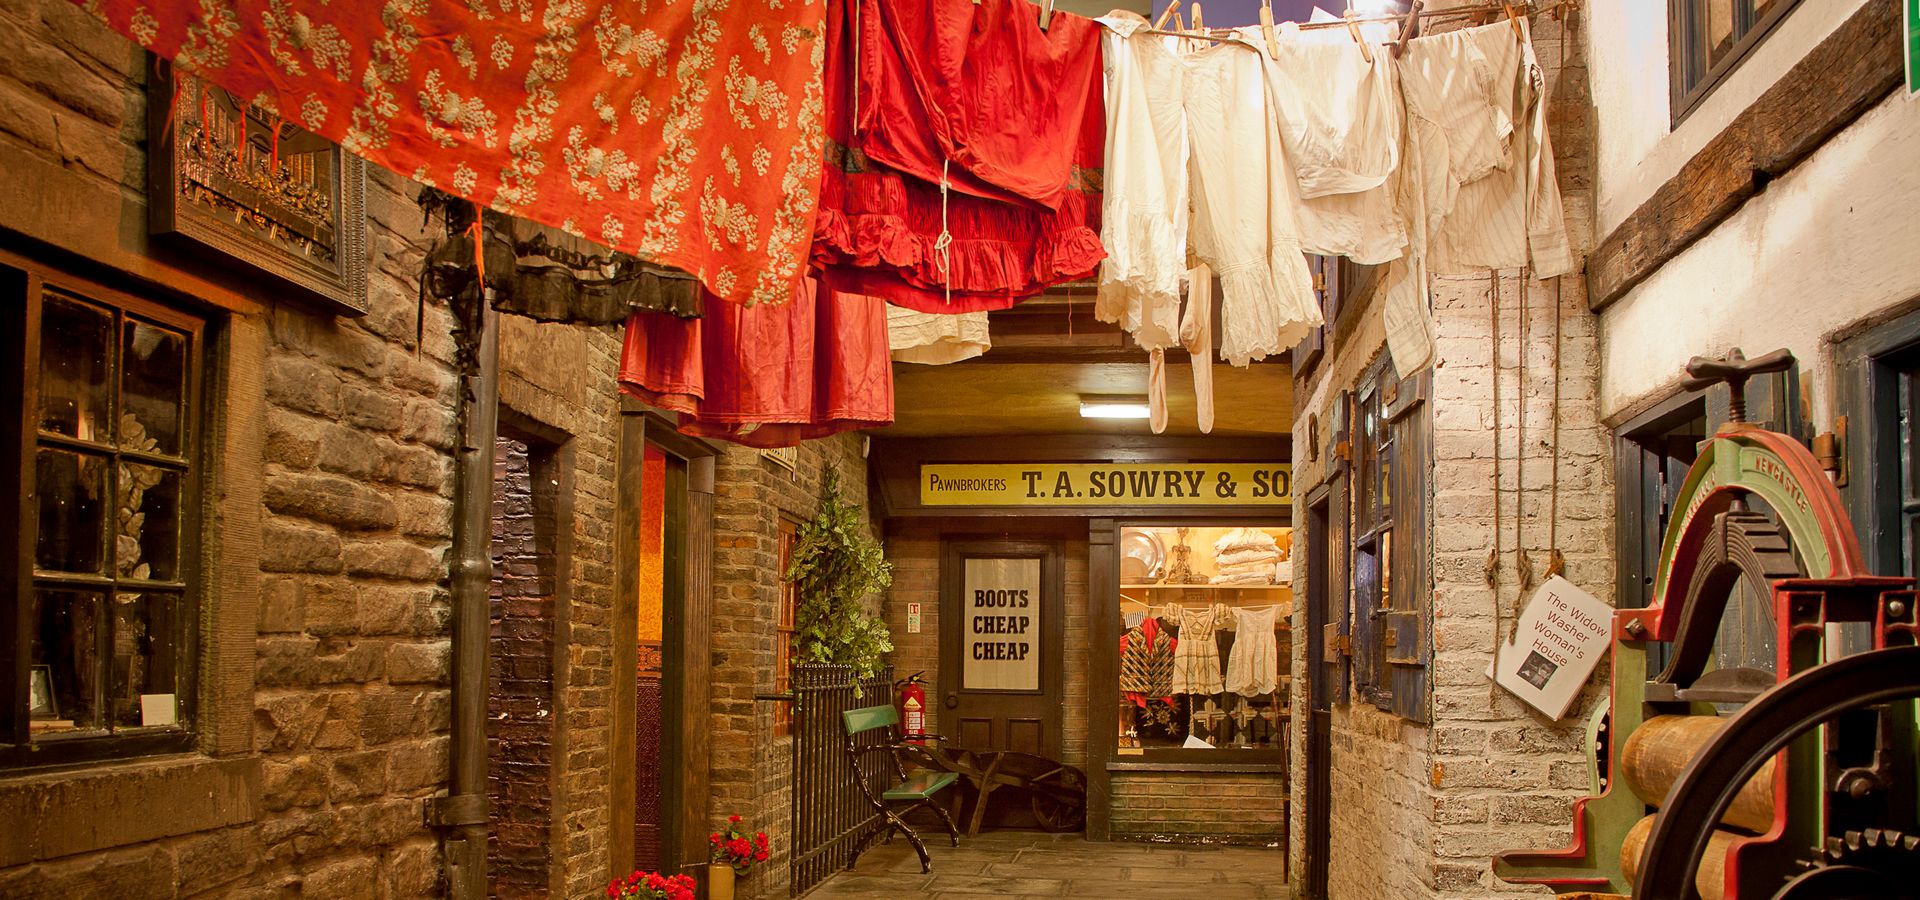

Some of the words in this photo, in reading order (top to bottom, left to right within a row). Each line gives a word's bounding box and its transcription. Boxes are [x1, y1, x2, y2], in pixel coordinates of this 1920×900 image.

[1089, 470, 1206, 498] SOWRY
[1215, 471, 1238, 498] &
[1252, 470, 1293, 498] SO
[1755, 455, 1809, 515] NEWCASTLE
[974, 589, 1029, 608] BOOTS
[973, 615, 1030, 634] CHEAP
[1547, 591, 1568, 612] The
[1570, 607, 1608, 638] Widow
[1547, 610, 1591, 644] Washer
[973, 642, 1030, 660] CHEAP
[1532, 638, 1568, 667] House
[1534, 620, 1586, 660] Woman's
